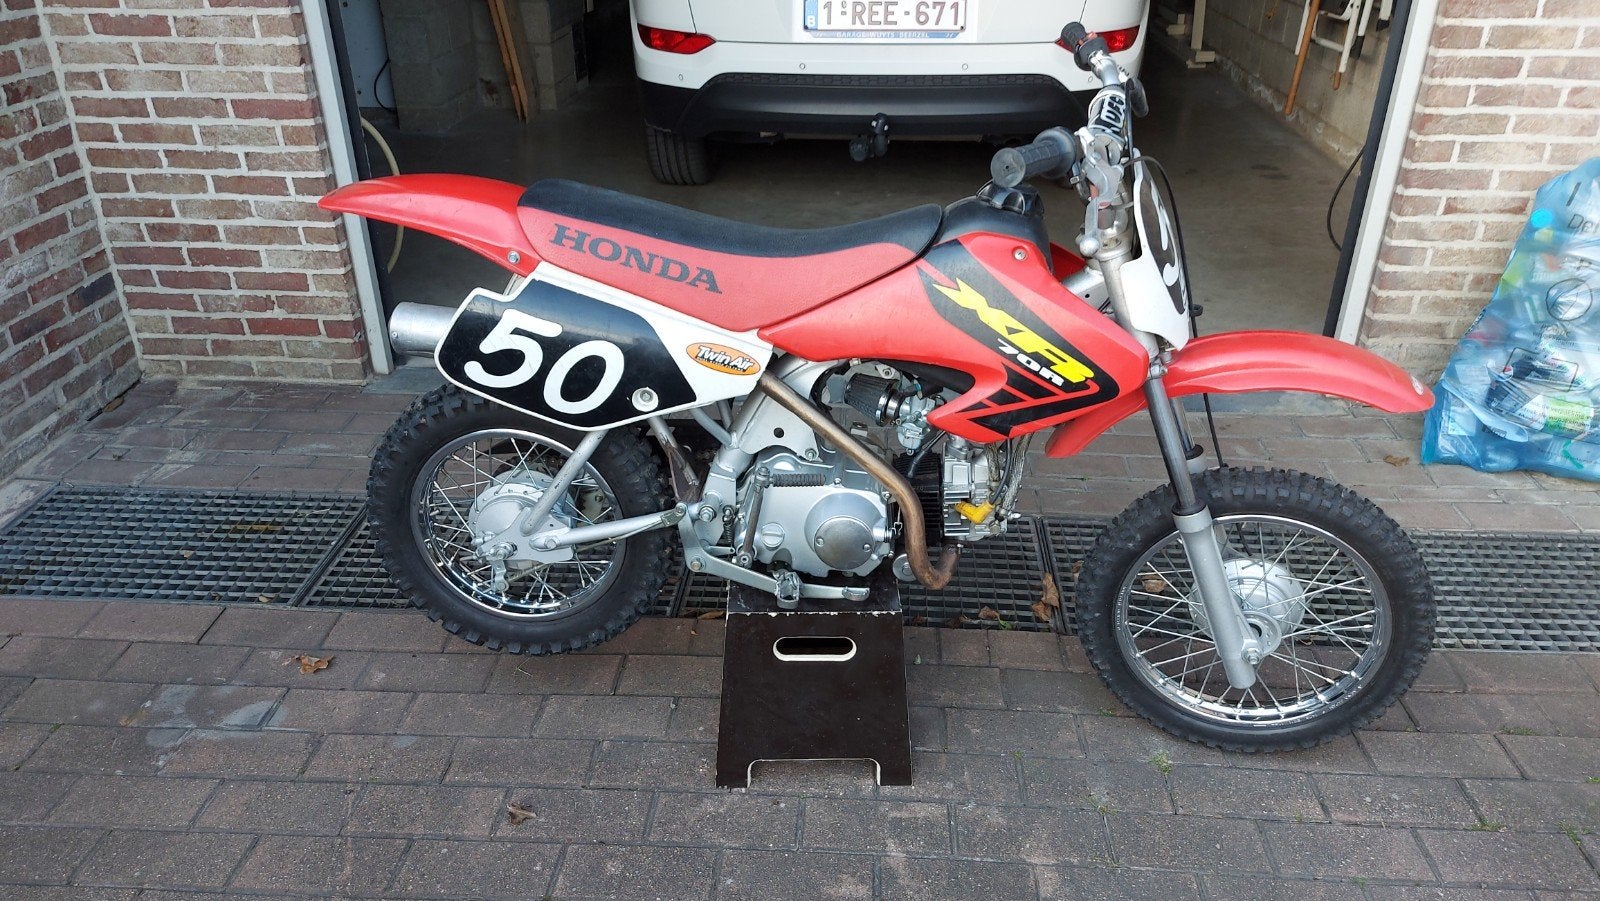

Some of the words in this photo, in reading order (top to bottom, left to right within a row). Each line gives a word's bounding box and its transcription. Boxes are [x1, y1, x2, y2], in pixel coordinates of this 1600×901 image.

[550, 223, 723, 295] HONDA
[463, 308, 625, 415] 50
[697, 345, 731, 365] Twin
[729, 356, 754, 371] Air
[932, 277, 1095, 384] XR
[997, 337, 1066, 388] 70R
